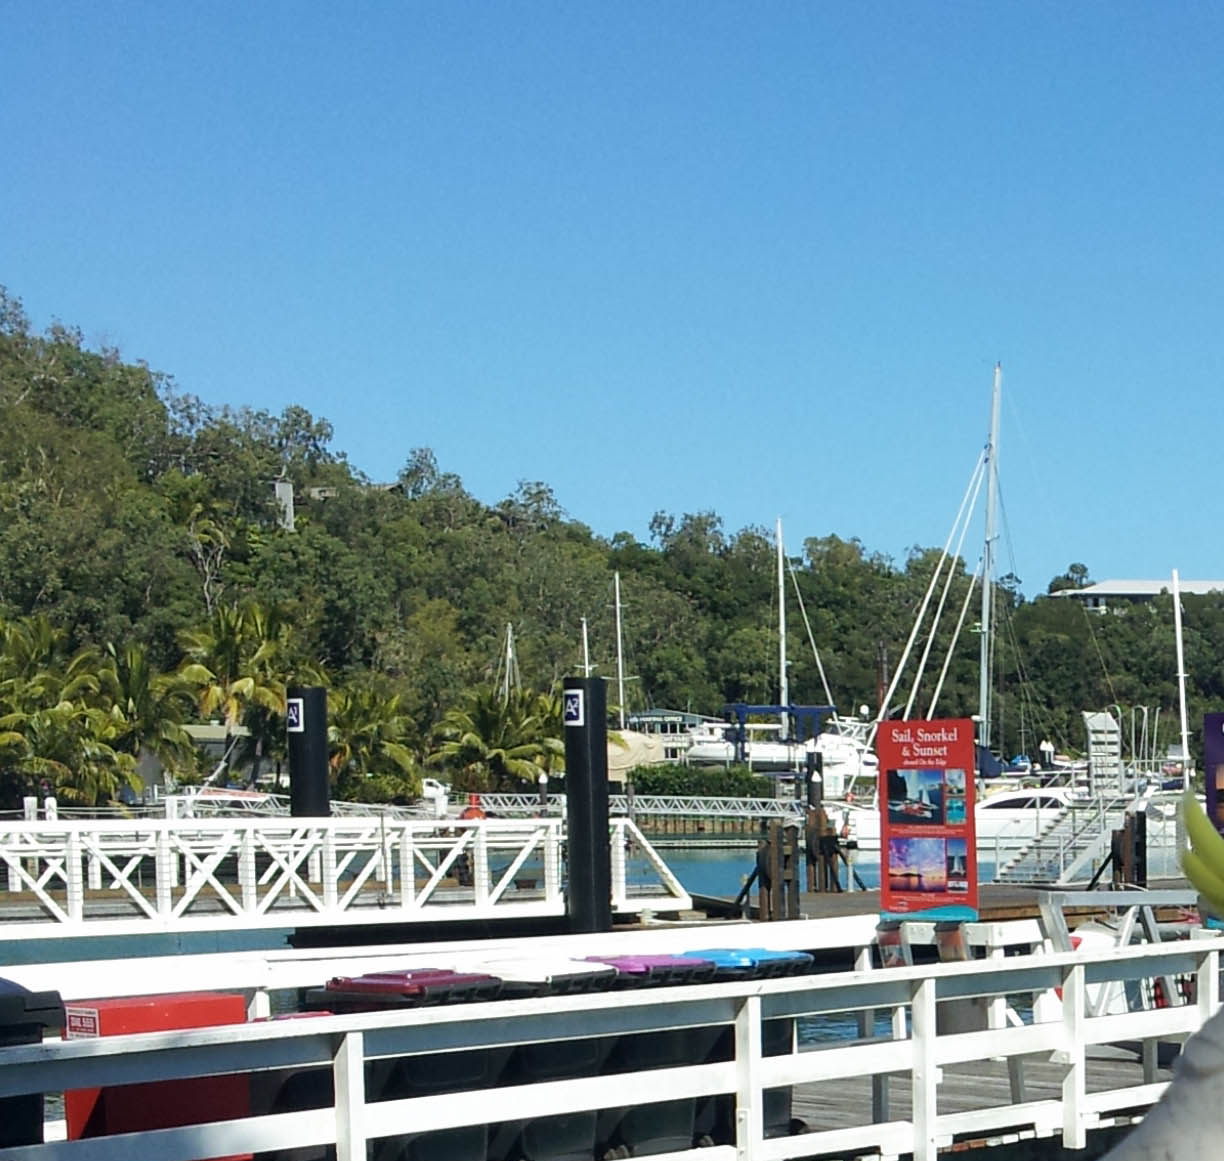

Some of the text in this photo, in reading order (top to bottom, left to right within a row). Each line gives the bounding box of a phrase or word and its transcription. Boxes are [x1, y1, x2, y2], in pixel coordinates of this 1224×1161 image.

[892, 727, 958, 743] Sail, Snorkel
[902, 743, 947, 757] & Sunset
